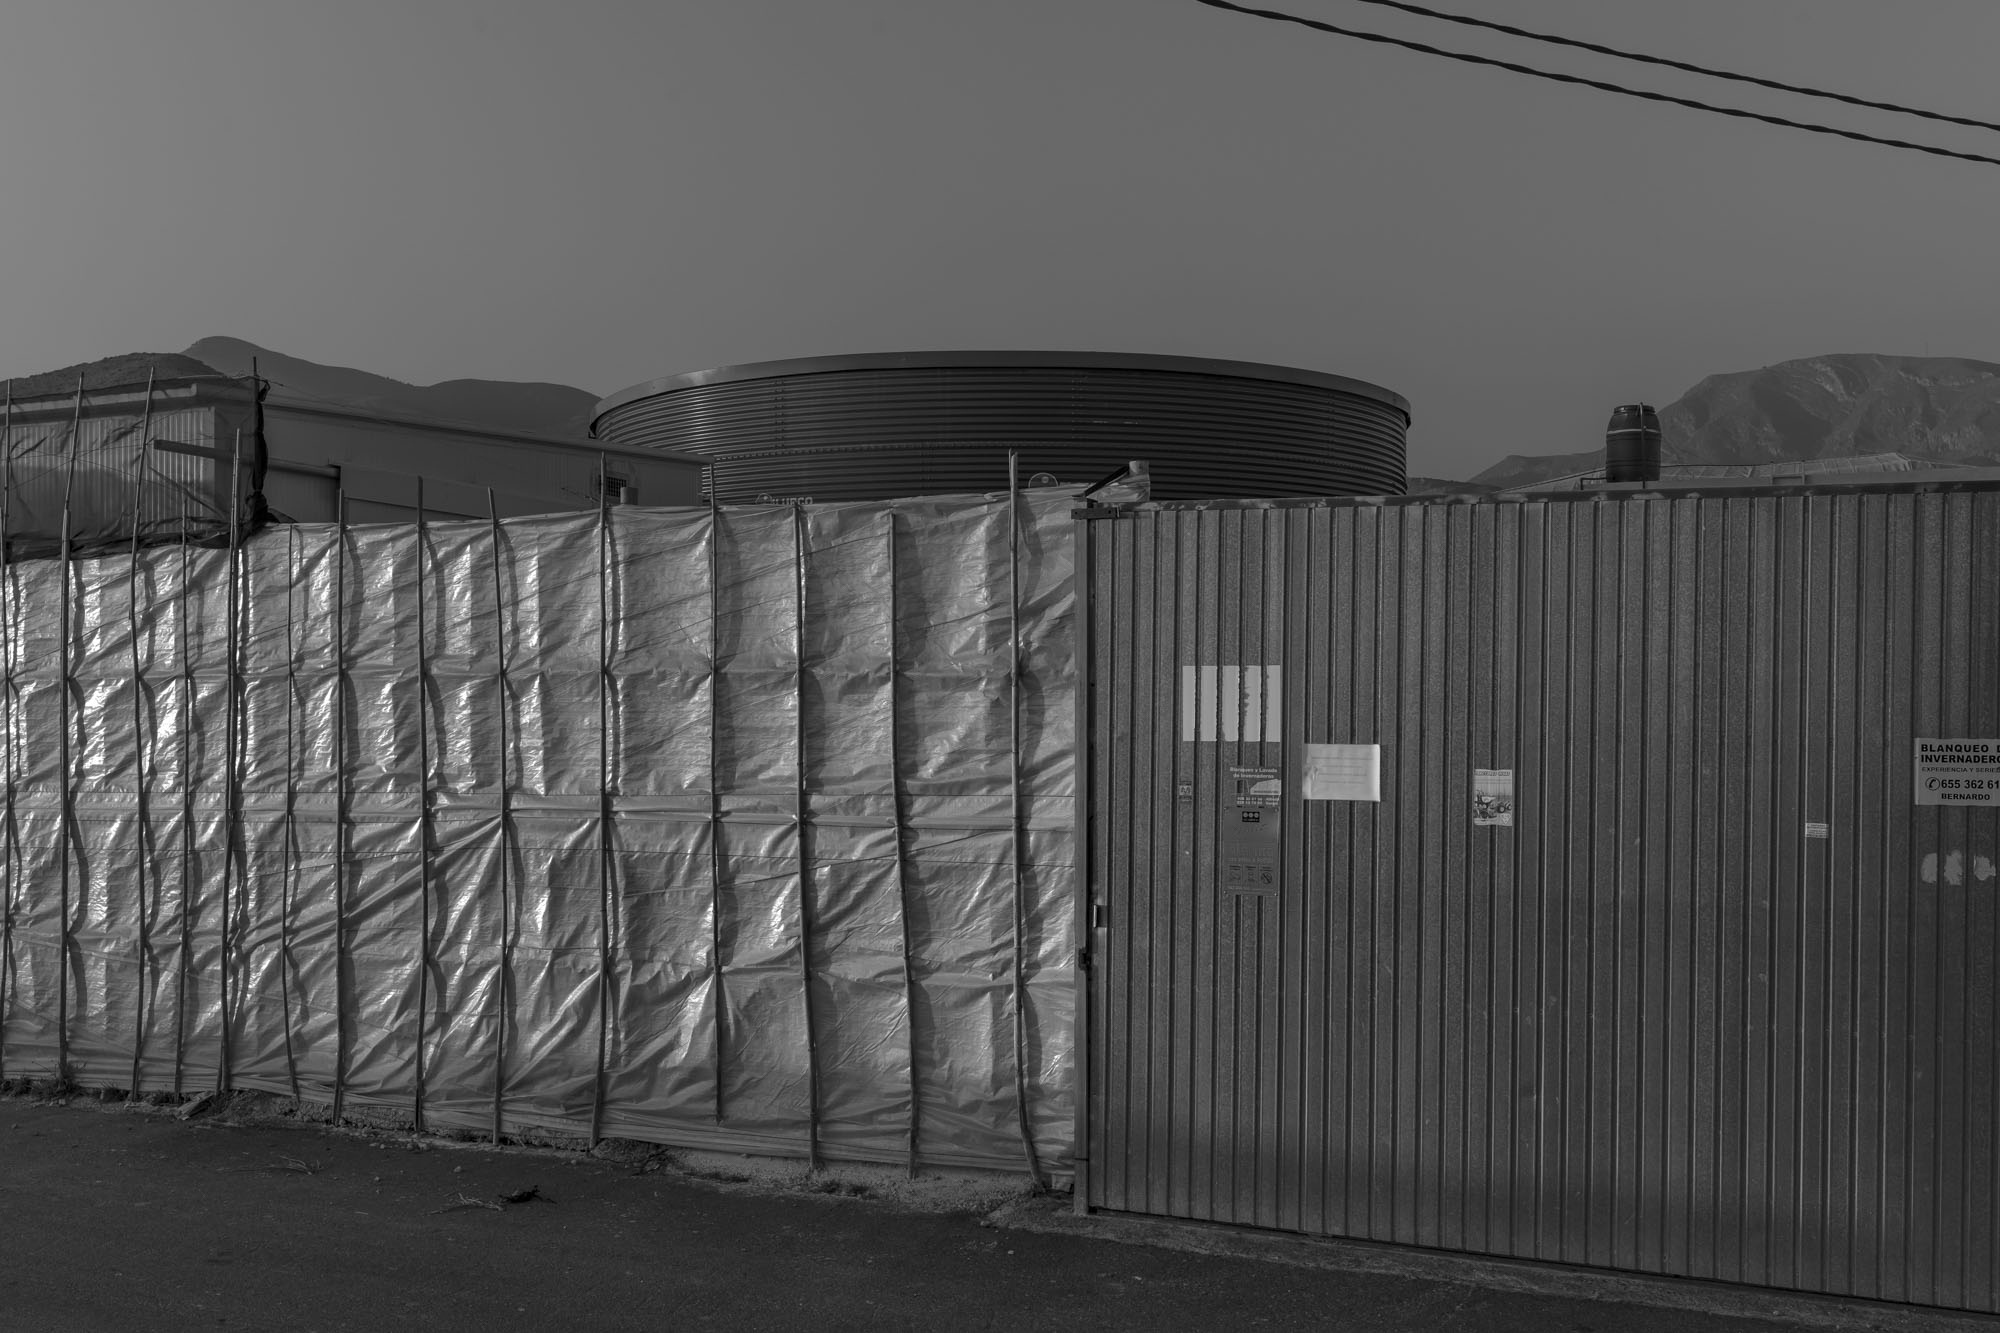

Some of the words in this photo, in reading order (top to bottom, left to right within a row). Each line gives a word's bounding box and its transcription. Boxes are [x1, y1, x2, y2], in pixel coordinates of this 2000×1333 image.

[1921, 744, 1989, 753] BLANQUEO
[1941, 779, 1961, 789] 655
[1963, 779, 1984, 789] 362
[1987, 779, 1999, 790] 61
[1941, 792, 1991, 801] BERNARDO
